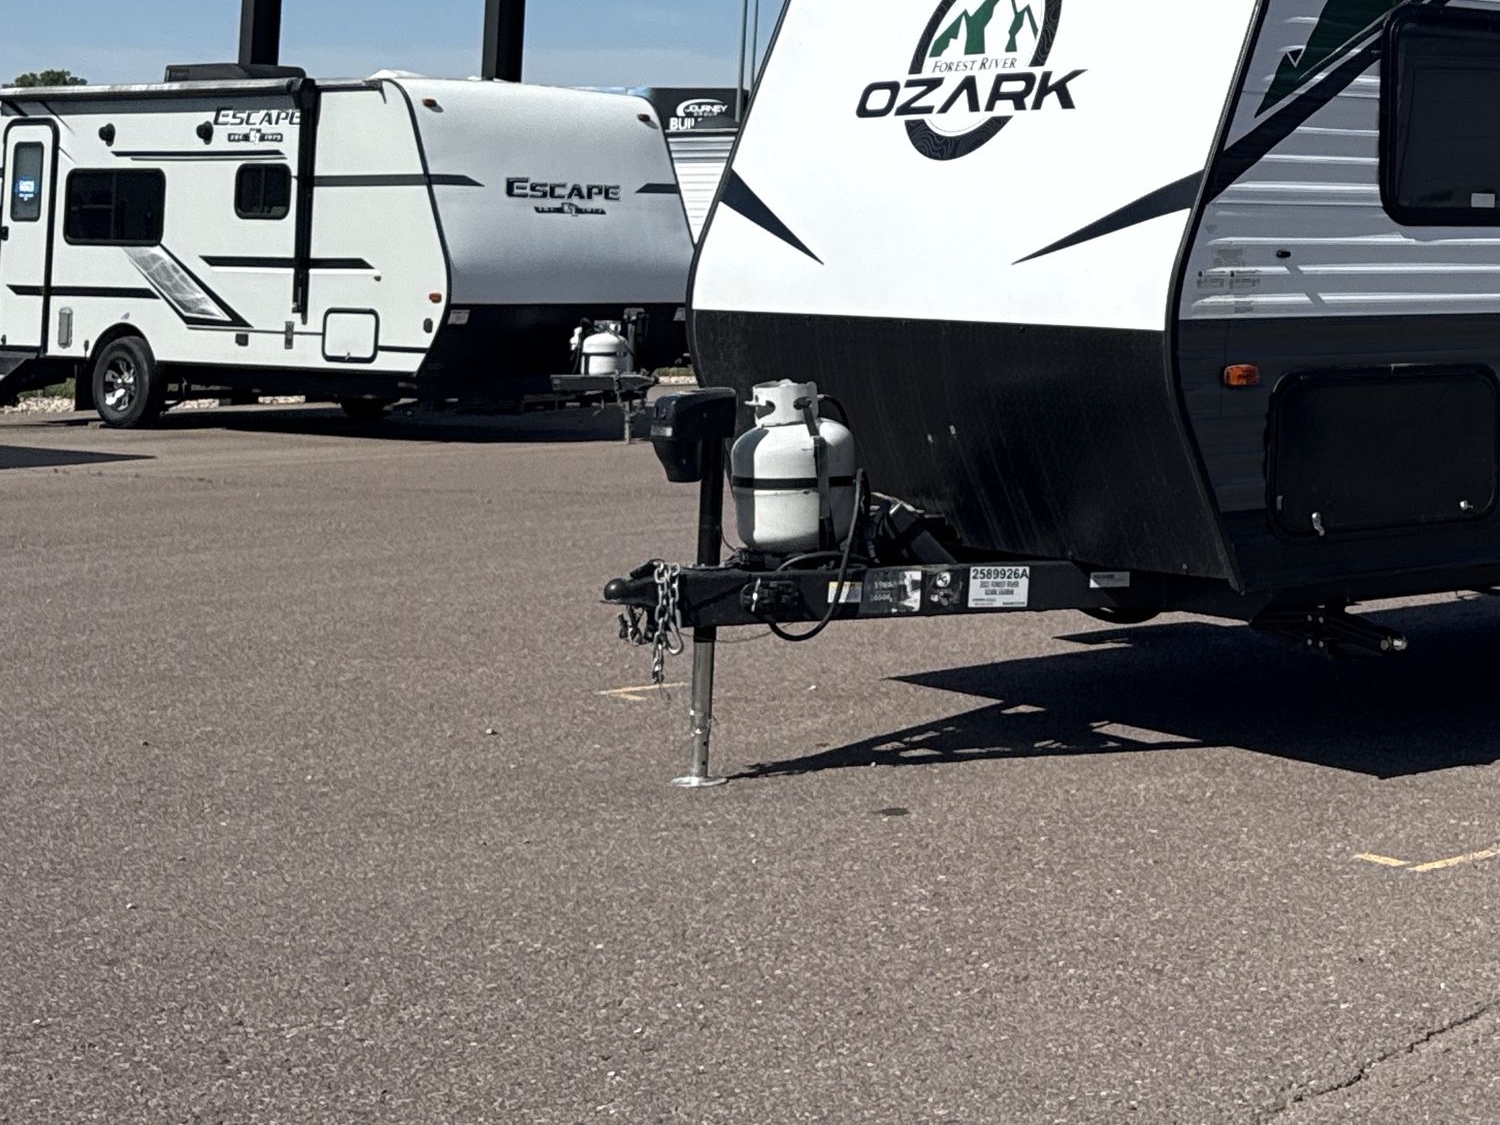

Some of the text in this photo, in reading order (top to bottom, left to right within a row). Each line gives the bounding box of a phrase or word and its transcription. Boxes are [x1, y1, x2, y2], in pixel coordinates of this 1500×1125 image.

[932, 57, 1017, 73] FOREST RIVER
[855, 68, 1089, 119] OZARK
[213, 107, 301, 125] ESCAPE
[506, 176, 620, 201] ESCAPE
[972, 568, 1029, 580] 2589926A
